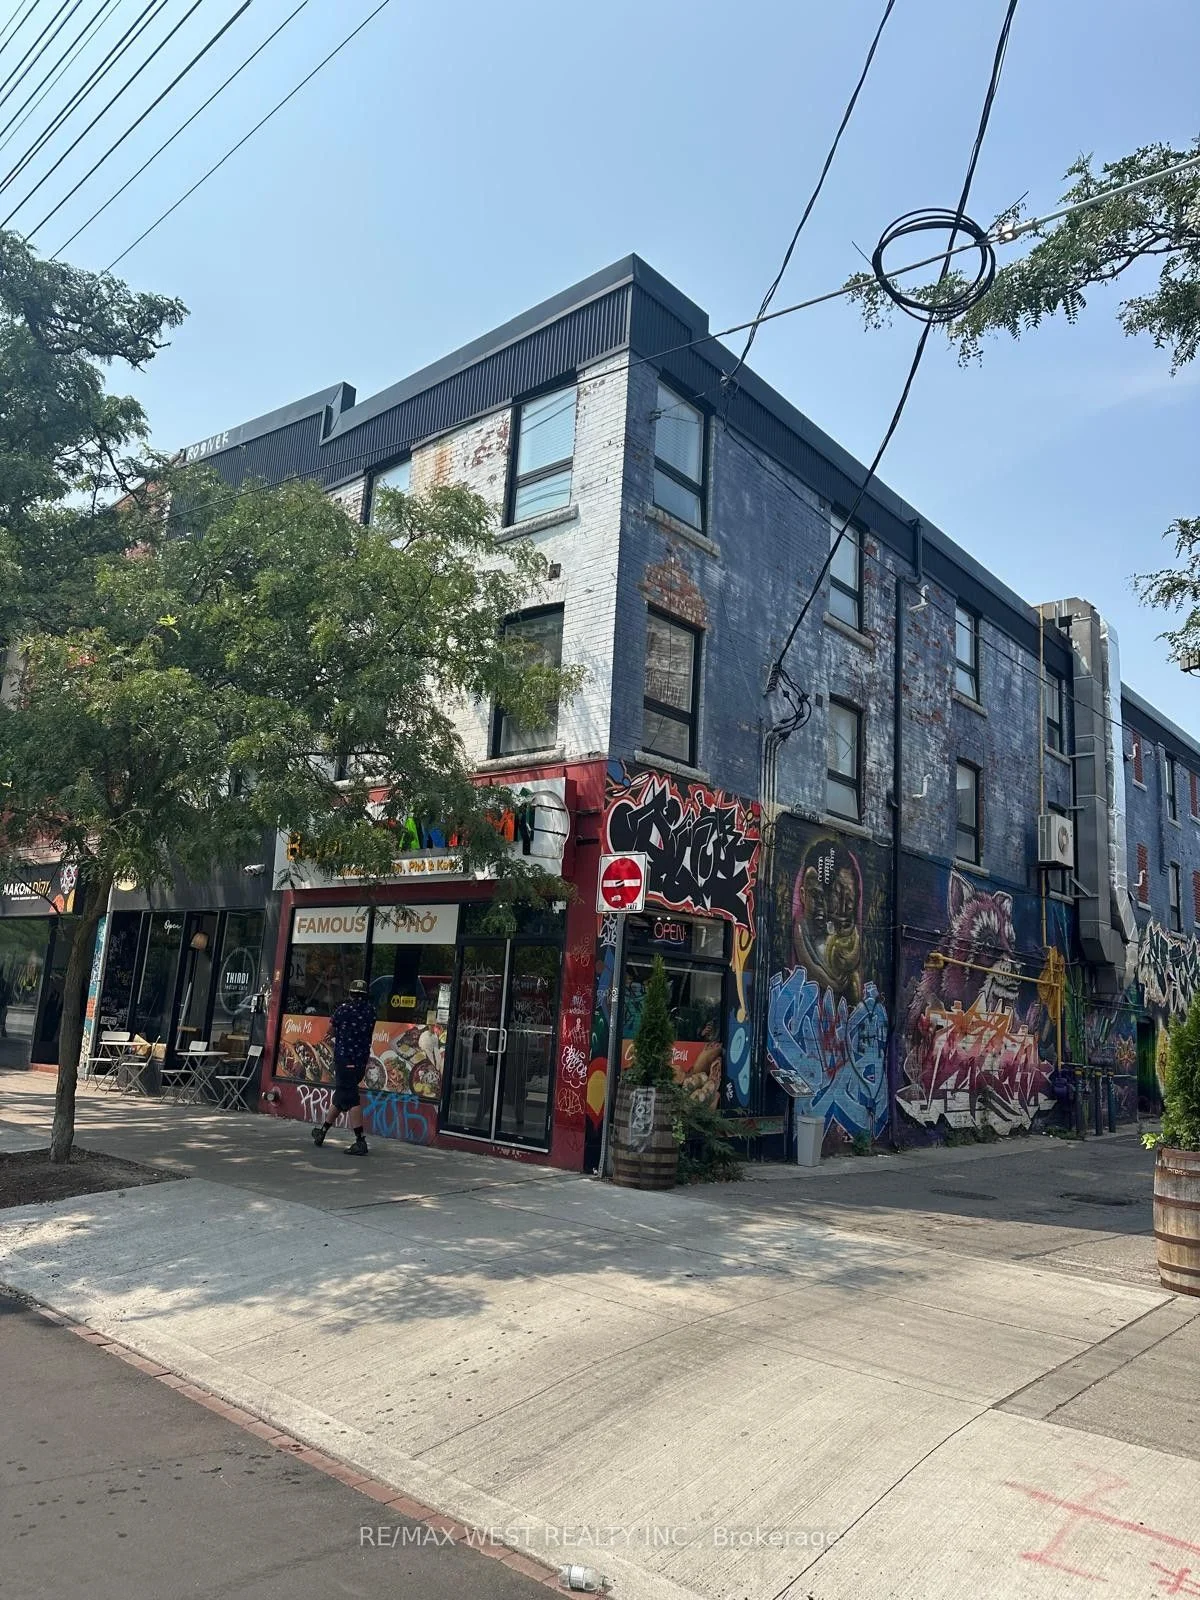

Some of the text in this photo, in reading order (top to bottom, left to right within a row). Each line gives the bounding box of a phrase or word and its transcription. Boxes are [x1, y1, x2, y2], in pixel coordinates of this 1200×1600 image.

[163, 919, 182, 935] Open
[297, 915, 367, 934] FAMOUS
[654, 921, 685, 942] OPEN
